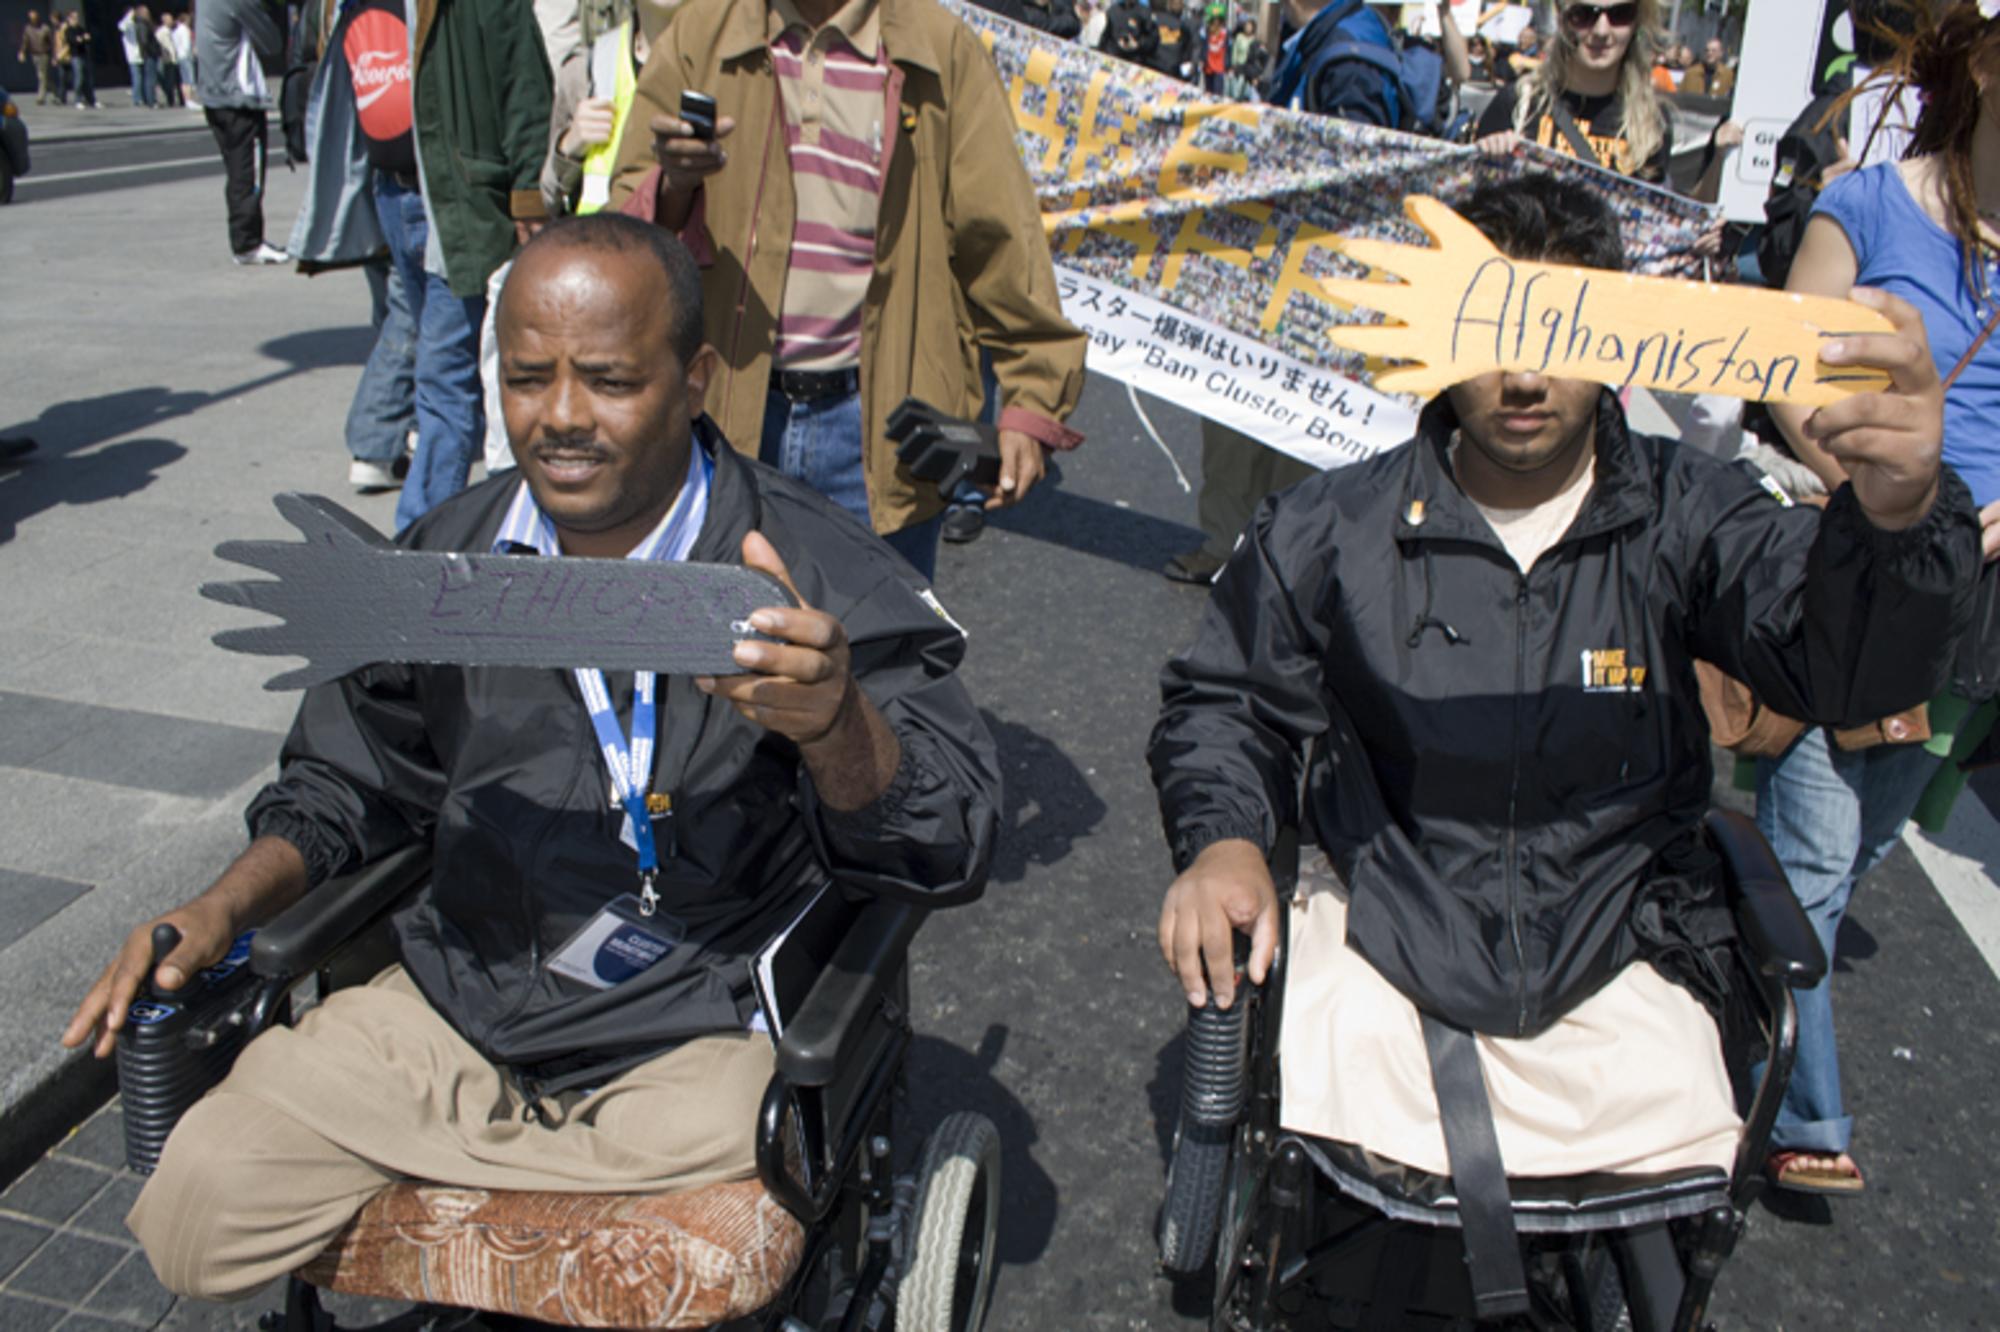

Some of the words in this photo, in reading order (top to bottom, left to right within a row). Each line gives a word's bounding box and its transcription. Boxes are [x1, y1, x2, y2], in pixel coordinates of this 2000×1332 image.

[1058, 275, 1376, 427] ラスター爆弾はいりません！
[1080, 322, 1127, 356] say
[1204, 370, 1304, 427] Cluster
[1451, 256, 1801, 401] Afghanistan
